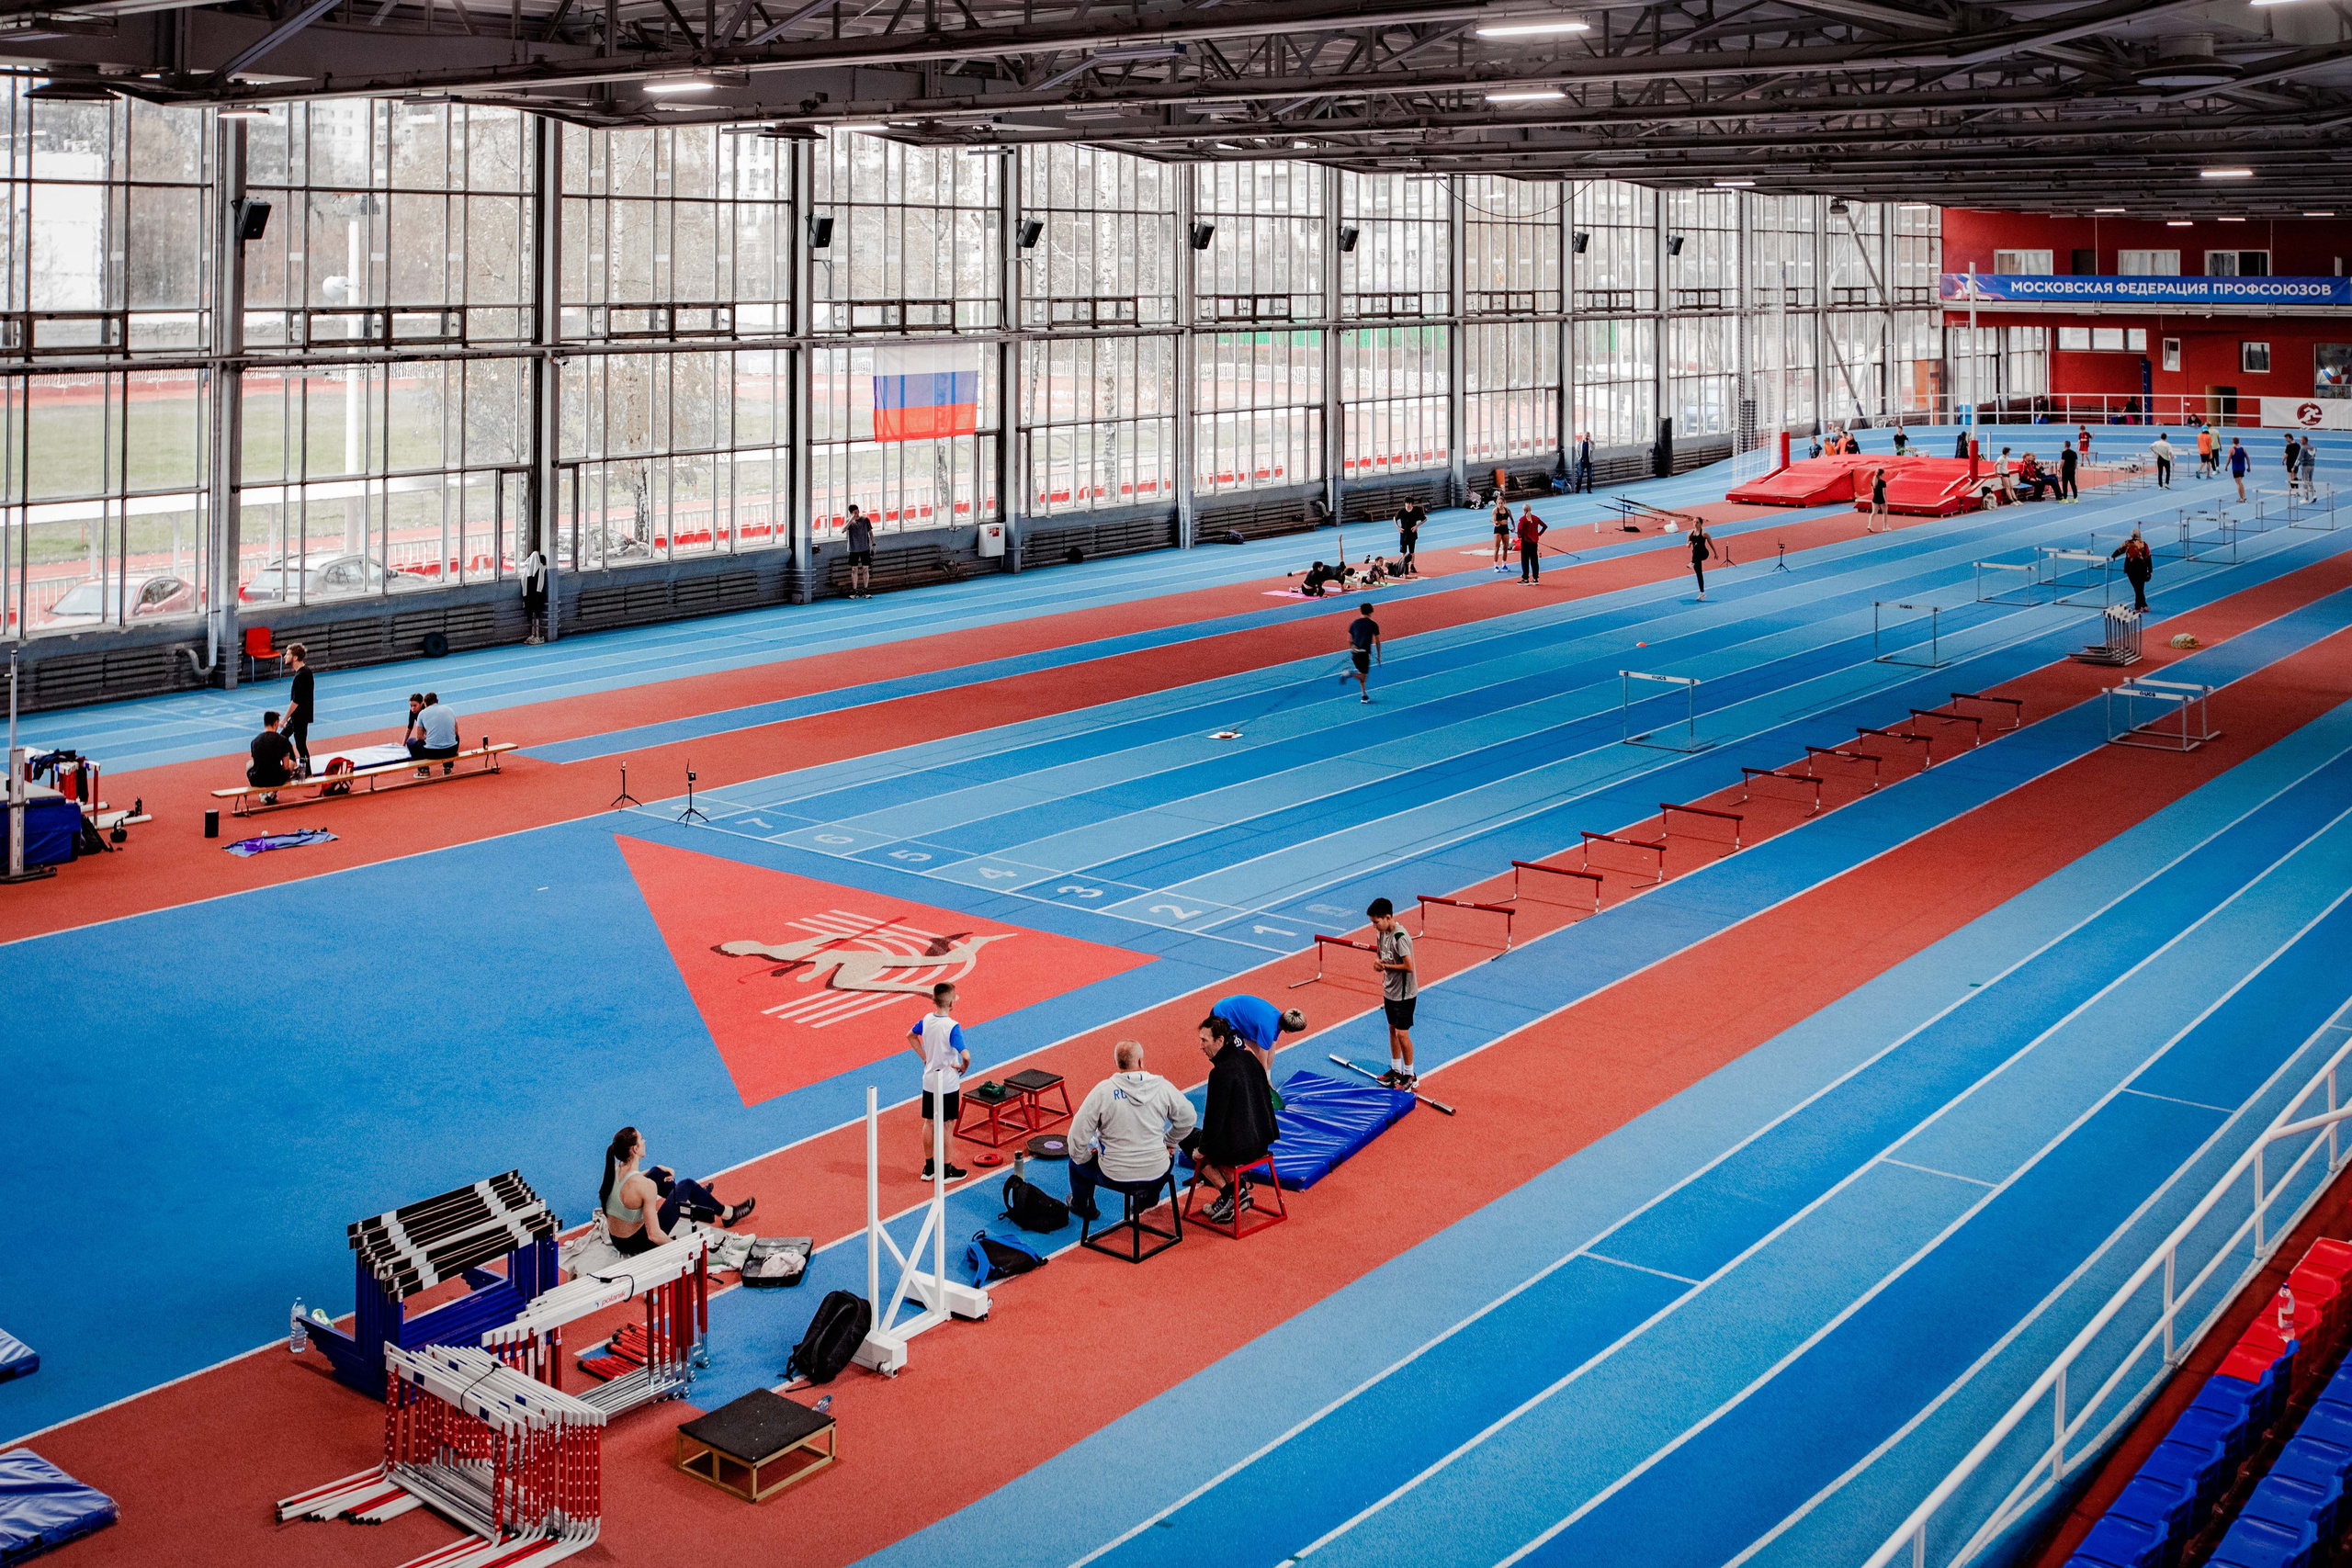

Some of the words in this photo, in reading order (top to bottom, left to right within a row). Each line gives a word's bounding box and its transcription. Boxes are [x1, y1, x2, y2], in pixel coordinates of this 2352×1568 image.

[2010, 281, 2113, 294] МОСКОВСКАЯ
[2116, 281, 2208, 296] ФЕДЕРАЦИЯ
[2213, 283, 2332, 297] ПРОФСОЮЗОВ
[734, 818, 774, 829] 7
[814, 833, 854, 845] 6
[888, 849, 932, 863] 5
[978, 866, 1018, 880] 4
[1057, 885, 1103, 898] 3
[1148, 904, 1203, 919] 2
[1252, 924, 1298, 937] 1
[601, 1290, 626, 1306] polanik
